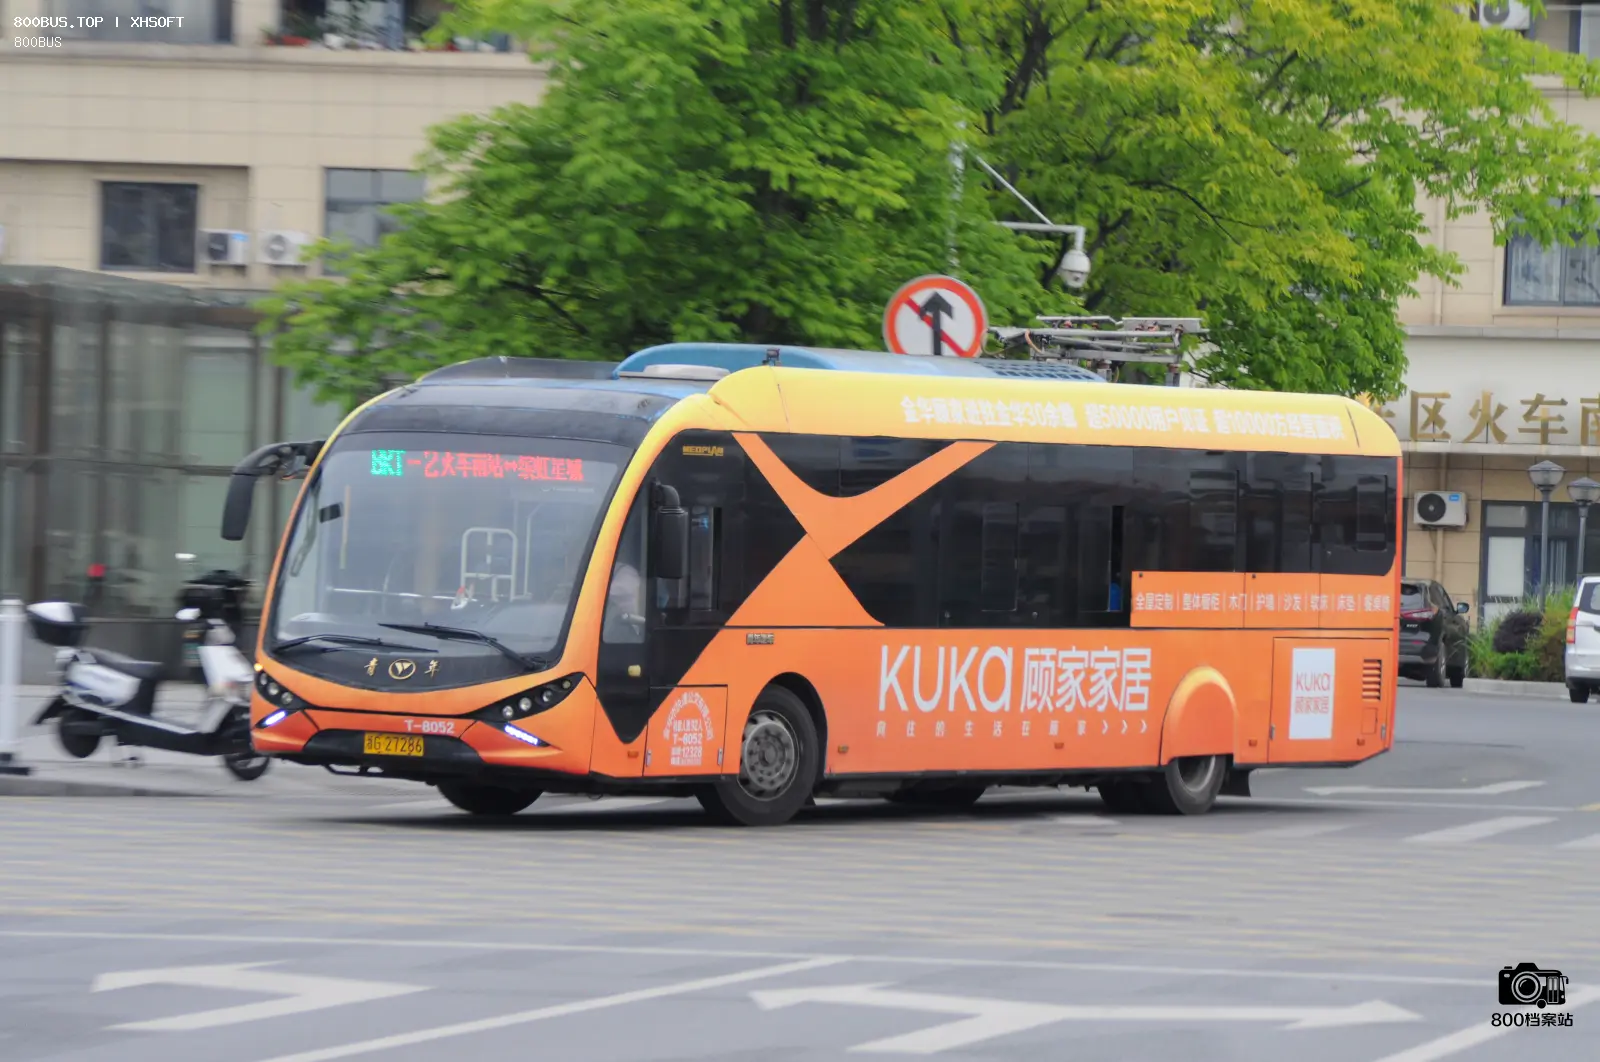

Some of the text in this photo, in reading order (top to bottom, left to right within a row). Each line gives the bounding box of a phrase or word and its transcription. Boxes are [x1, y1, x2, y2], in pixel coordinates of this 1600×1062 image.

[1020, 646, 1152, 713] 顾家家居
[404, 719, 455, 734] T-8052
